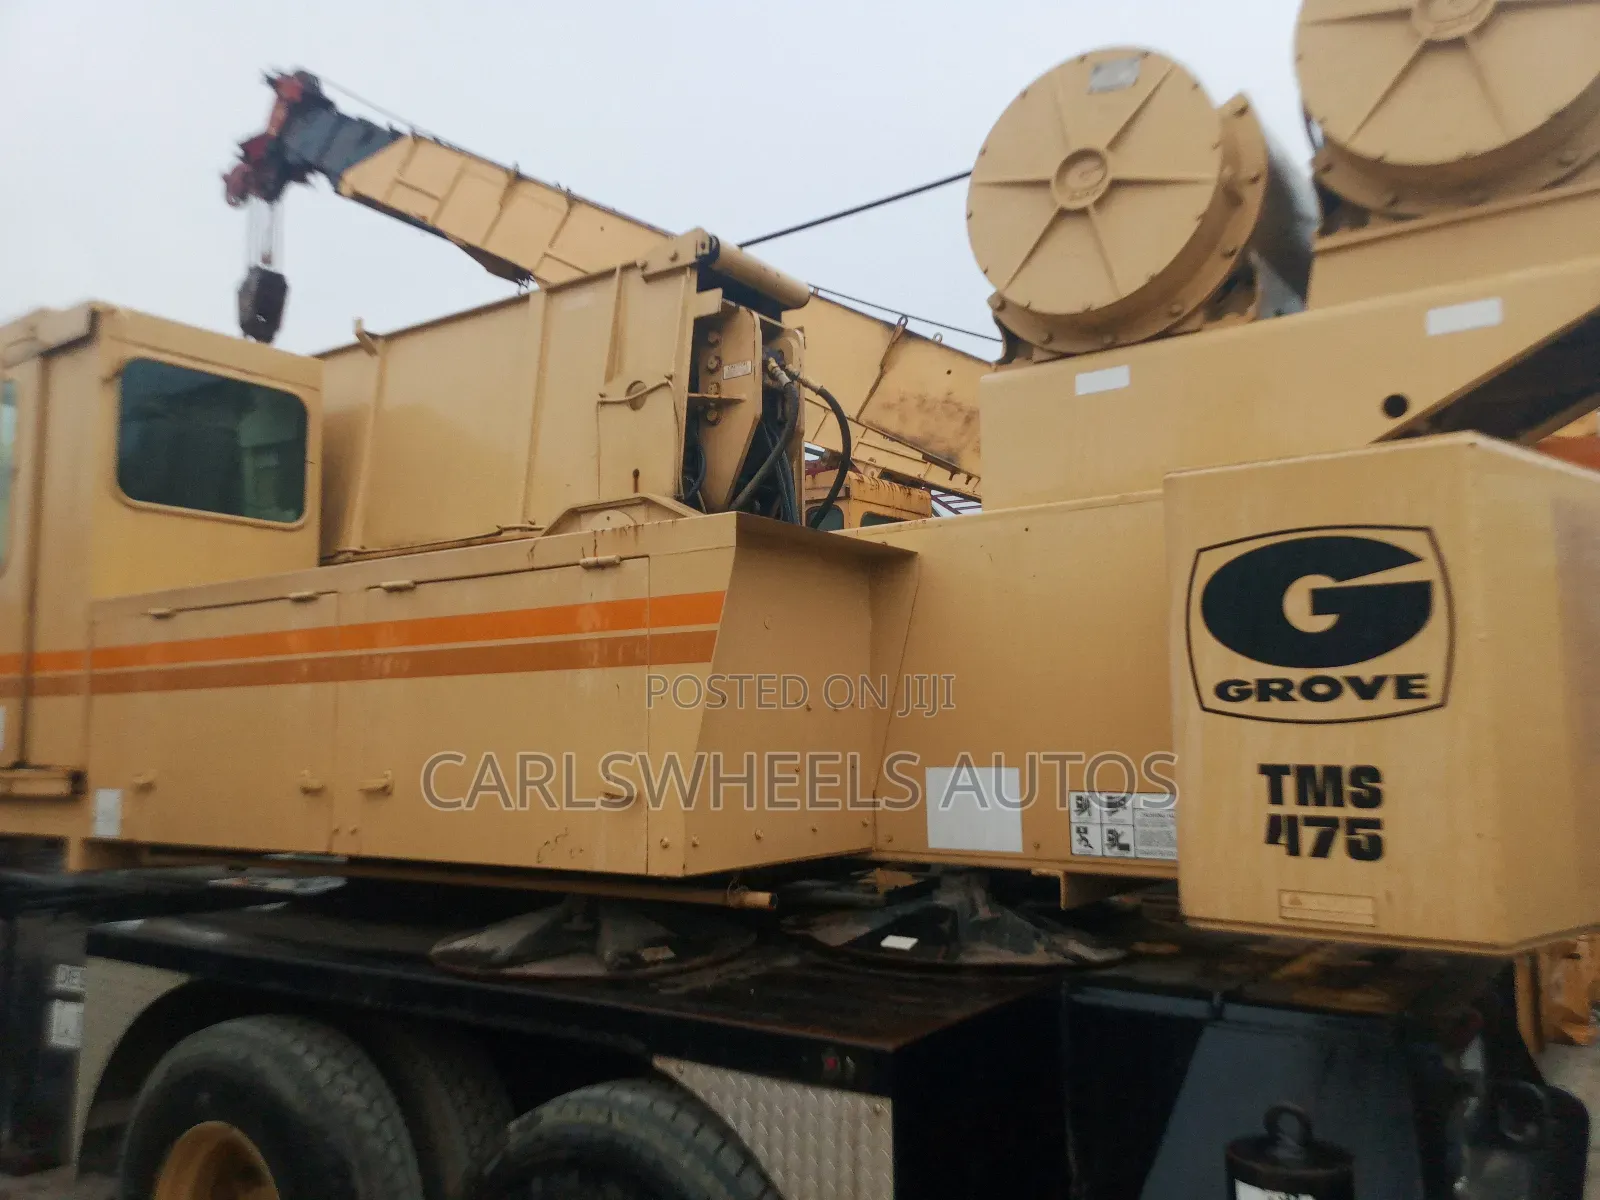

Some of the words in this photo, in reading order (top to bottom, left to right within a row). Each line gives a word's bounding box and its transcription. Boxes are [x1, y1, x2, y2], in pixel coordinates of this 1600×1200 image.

[1201, 537, 1432, 668] G
[1214, 675, 1428, 702] GROVE
[1258, 763, 1383, 809] TMS
[1265, 814, 1384, 861] 475
